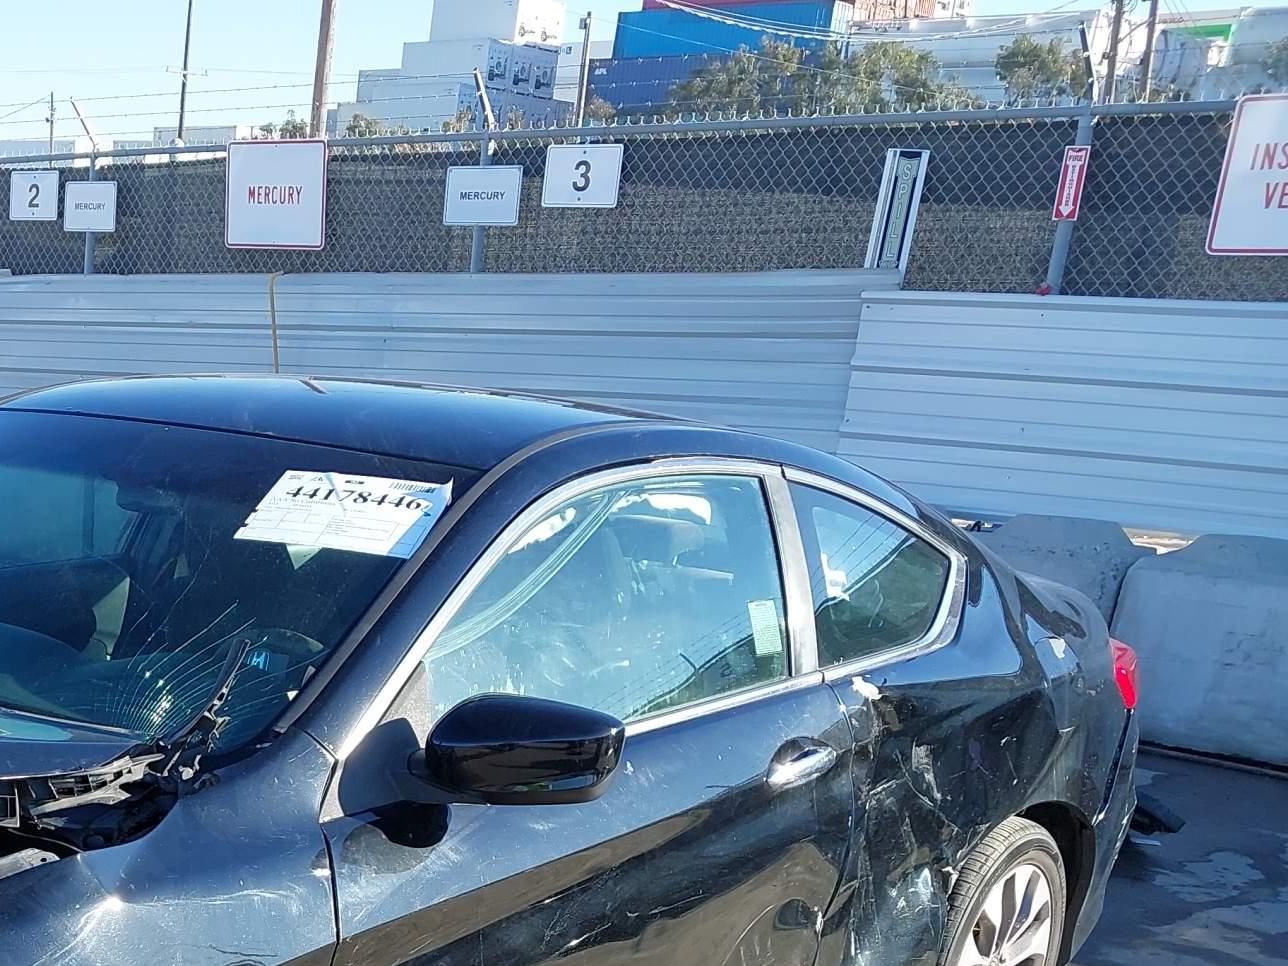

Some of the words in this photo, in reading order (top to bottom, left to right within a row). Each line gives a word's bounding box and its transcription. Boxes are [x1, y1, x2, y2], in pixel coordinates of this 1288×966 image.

[1068, 154, 1084, 162] FIRE
[572, 159, 592, 192] 3
[28, 183, 40, 208] 2
[74, 202, 106, 210] MERCURY
[247, 185, 303, 205] MERCURY
[459, 191, 506, 201] MERCURY
[886, 164, 912, 257] SPILL
[285, 485, 422, 511] 44178446
